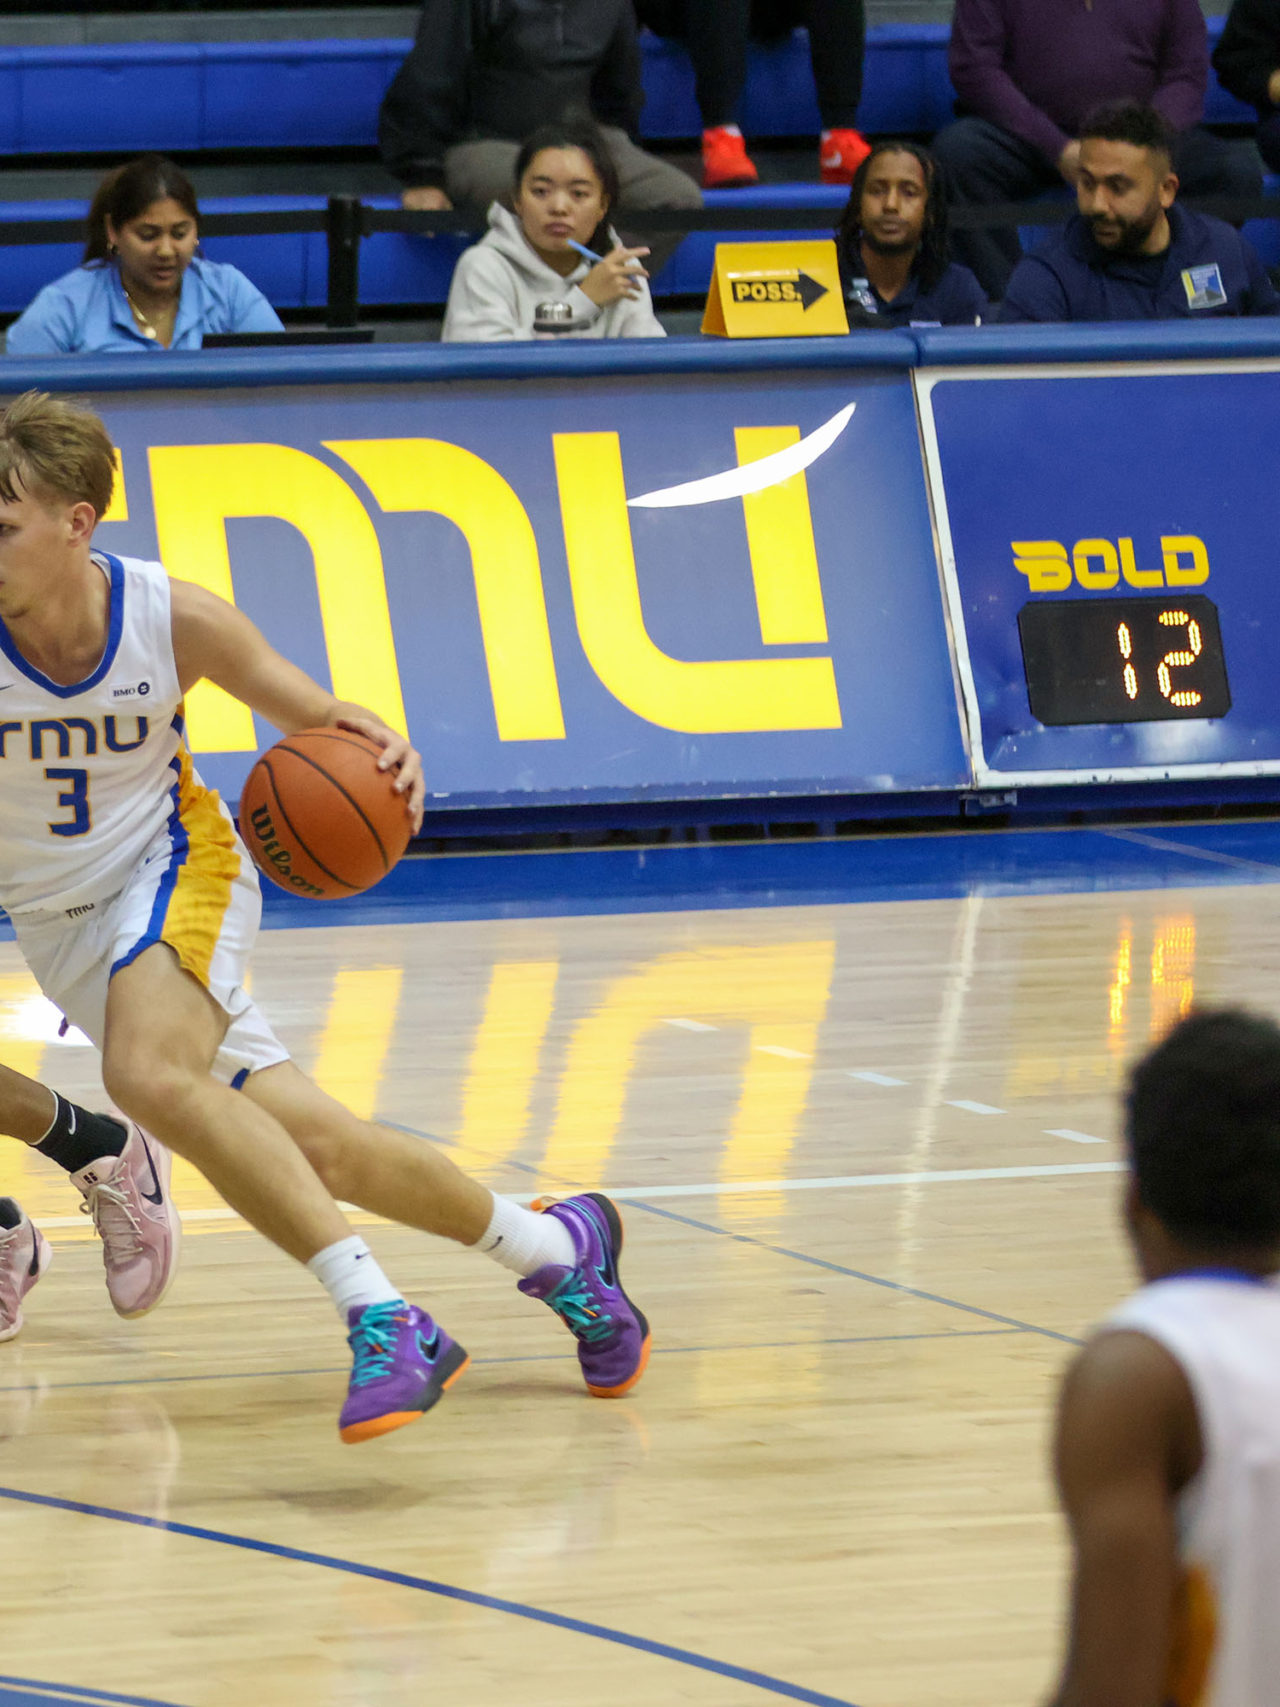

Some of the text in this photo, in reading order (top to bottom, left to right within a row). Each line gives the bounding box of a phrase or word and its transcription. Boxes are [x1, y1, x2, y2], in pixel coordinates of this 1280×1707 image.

[735, 281, 802, 301] POSS.
[1011, 535, 1210, 592] BOLD
[1117, 611, 1202, 706] 12
[113, 688, 136, 697] BMO
[44, 767, 92, 837] 3
[251, 803, 325, 895] Wilson
[65, 903, 95, 919] TMU
